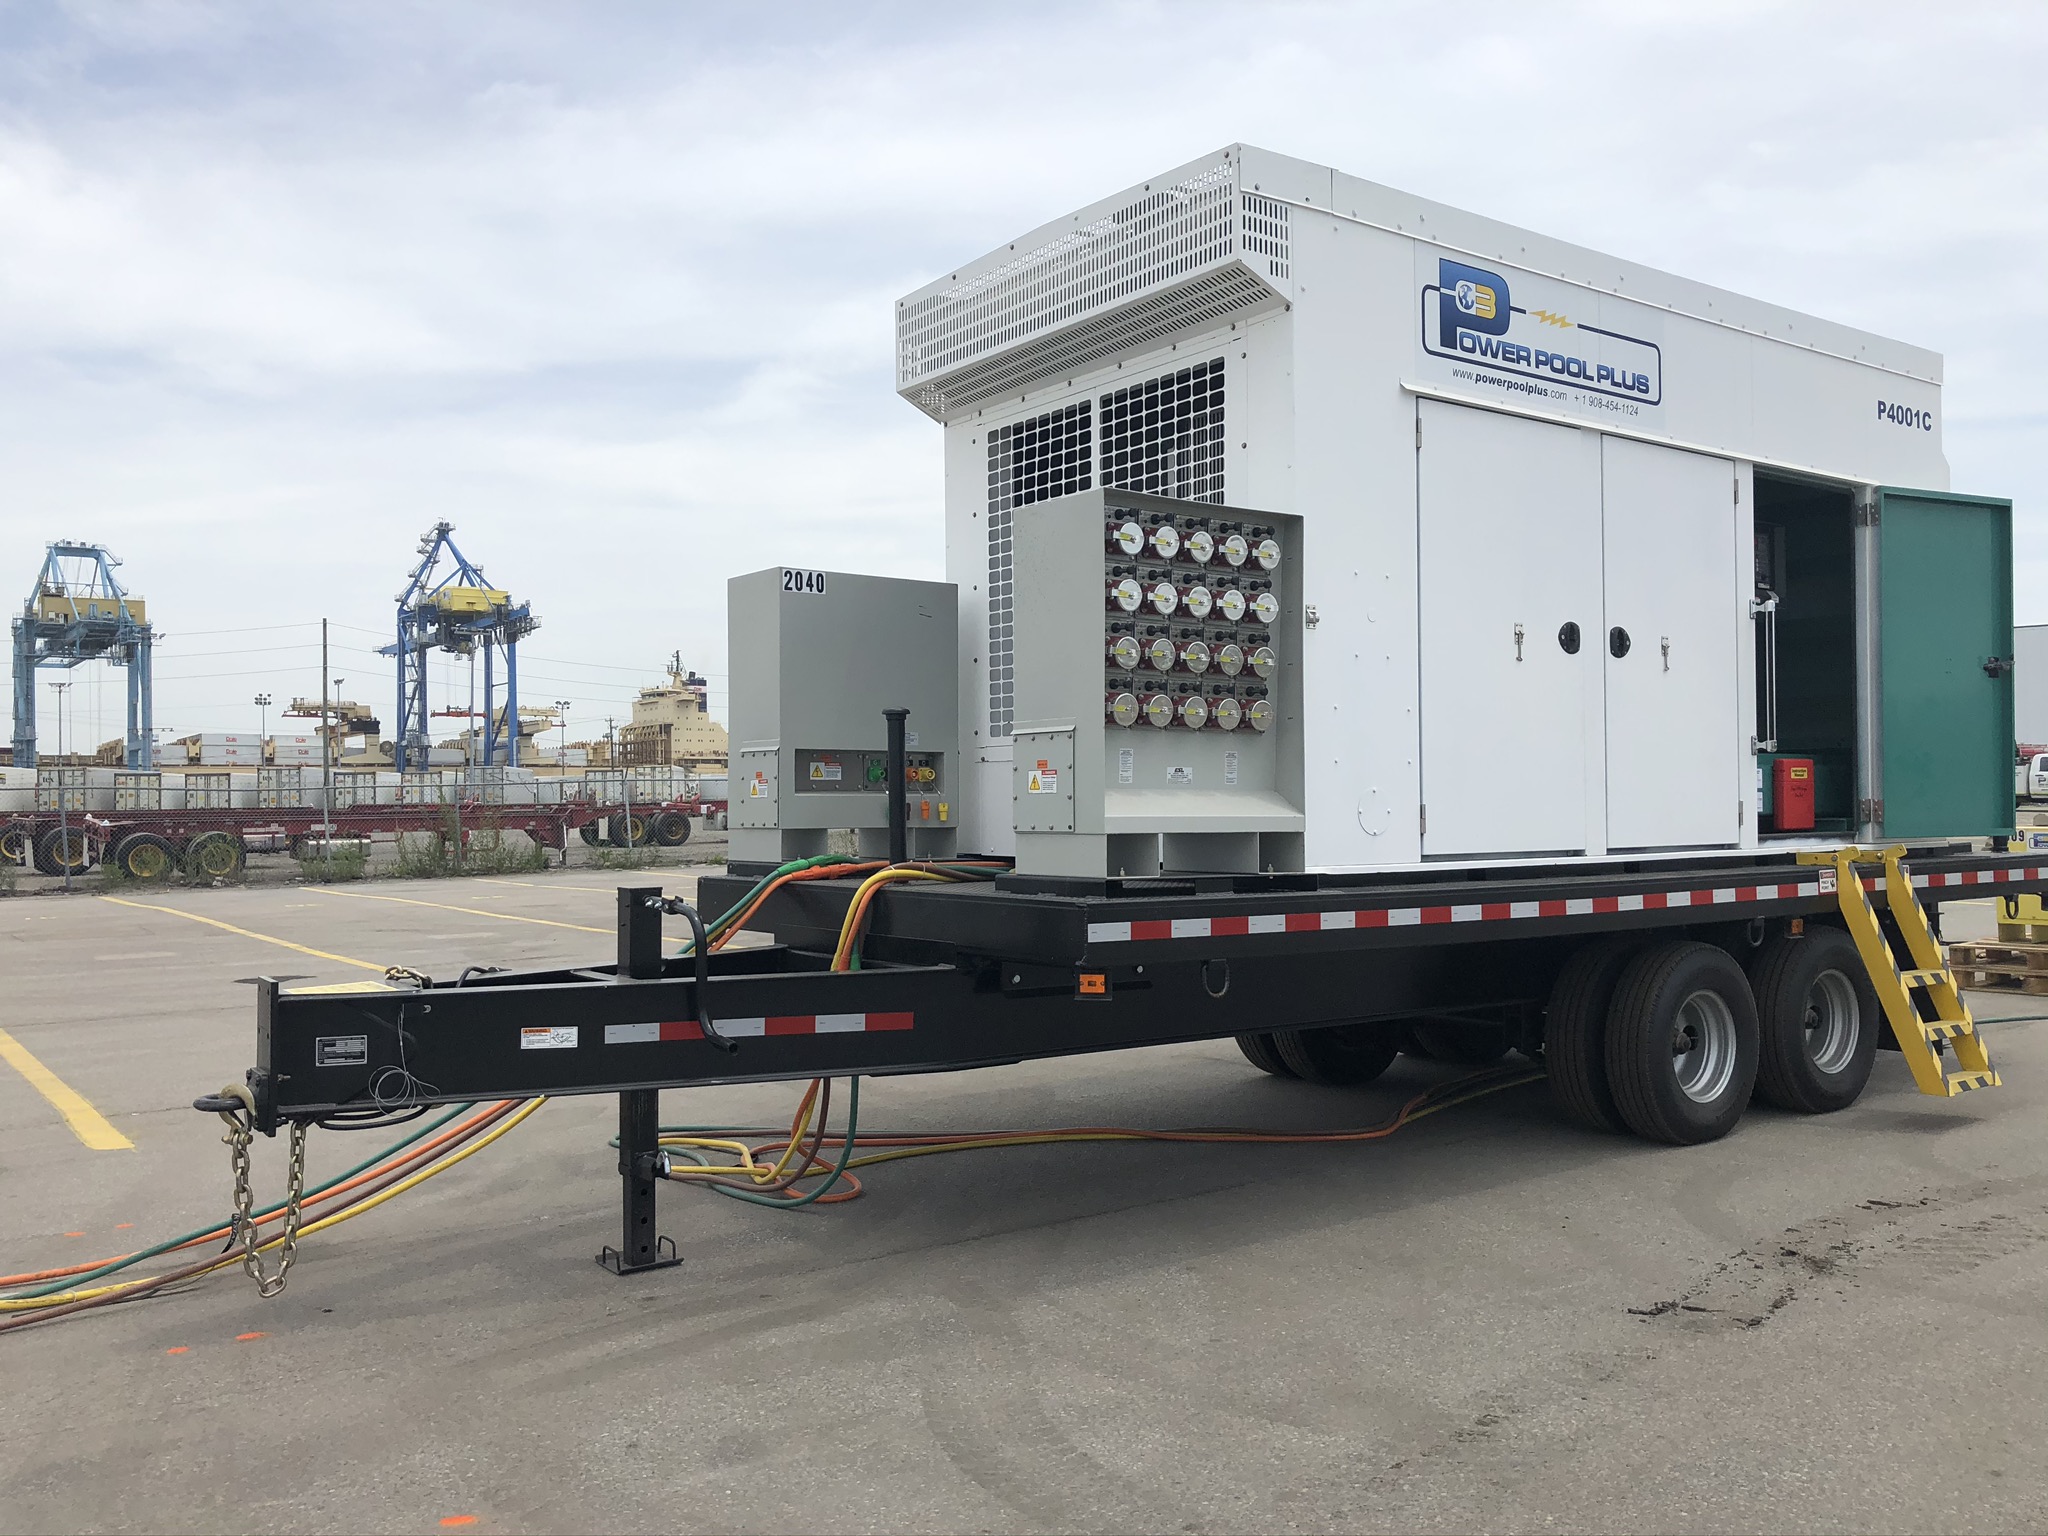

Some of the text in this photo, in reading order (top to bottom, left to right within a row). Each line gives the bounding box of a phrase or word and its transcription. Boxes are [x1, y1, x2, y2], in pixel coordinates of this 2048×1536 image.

[1452, 367, 1568, 401] www.powerpoolplus.com
[1588, 395, 1639, 417] 908-454-1124
[1535, 350, 1595, 382] POOL
[1597, 364, 1650, 395] PLUS
[1877, 399, 1932, 432] P4001C
[783, 570, 825, 594] 2040
